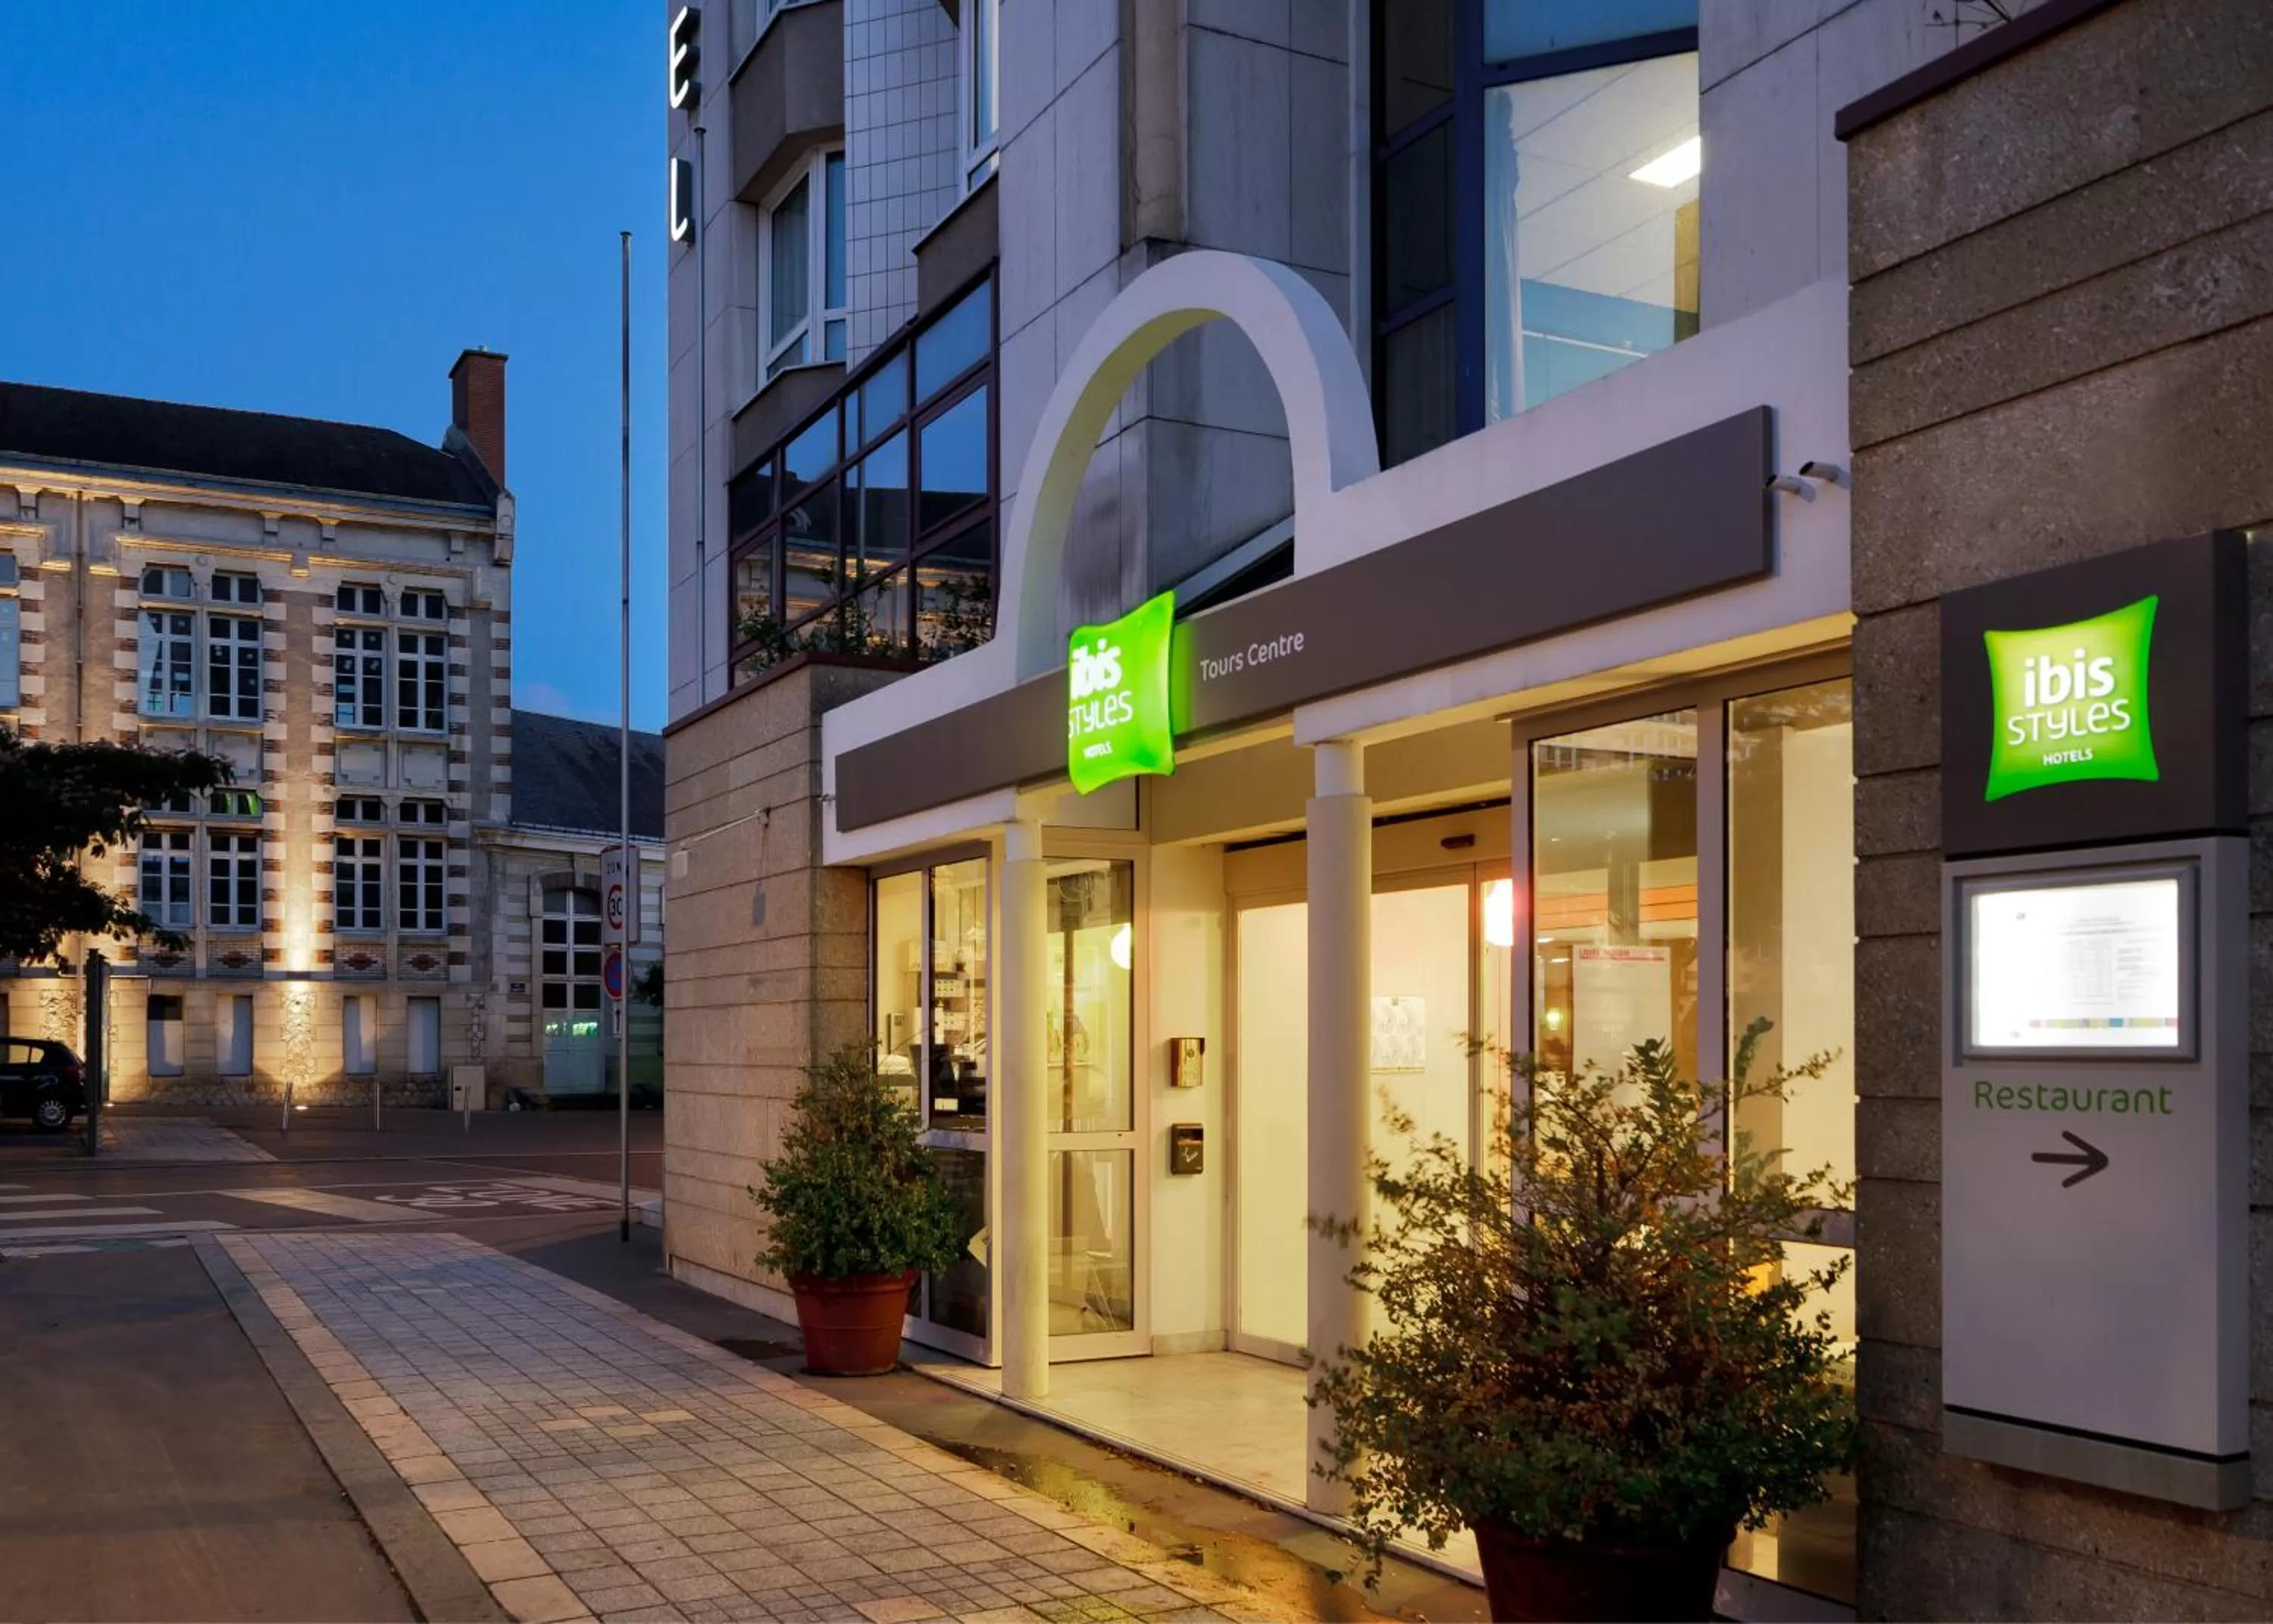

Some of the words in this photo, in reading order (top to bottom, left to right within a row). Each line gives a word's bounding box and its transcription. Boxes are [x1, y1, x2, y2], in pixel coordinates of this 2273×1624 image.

[1070, 638, 1123, 701] ibis
[1199, 652, 1243, 682] Tours
[1247, 632, 1305, 666] Centre
[2024, 648, 2115, 708] ibis
[2043, 748, 2094, 766] HOTELS
[1973, 1080, 2175, 1115] Restaurant
